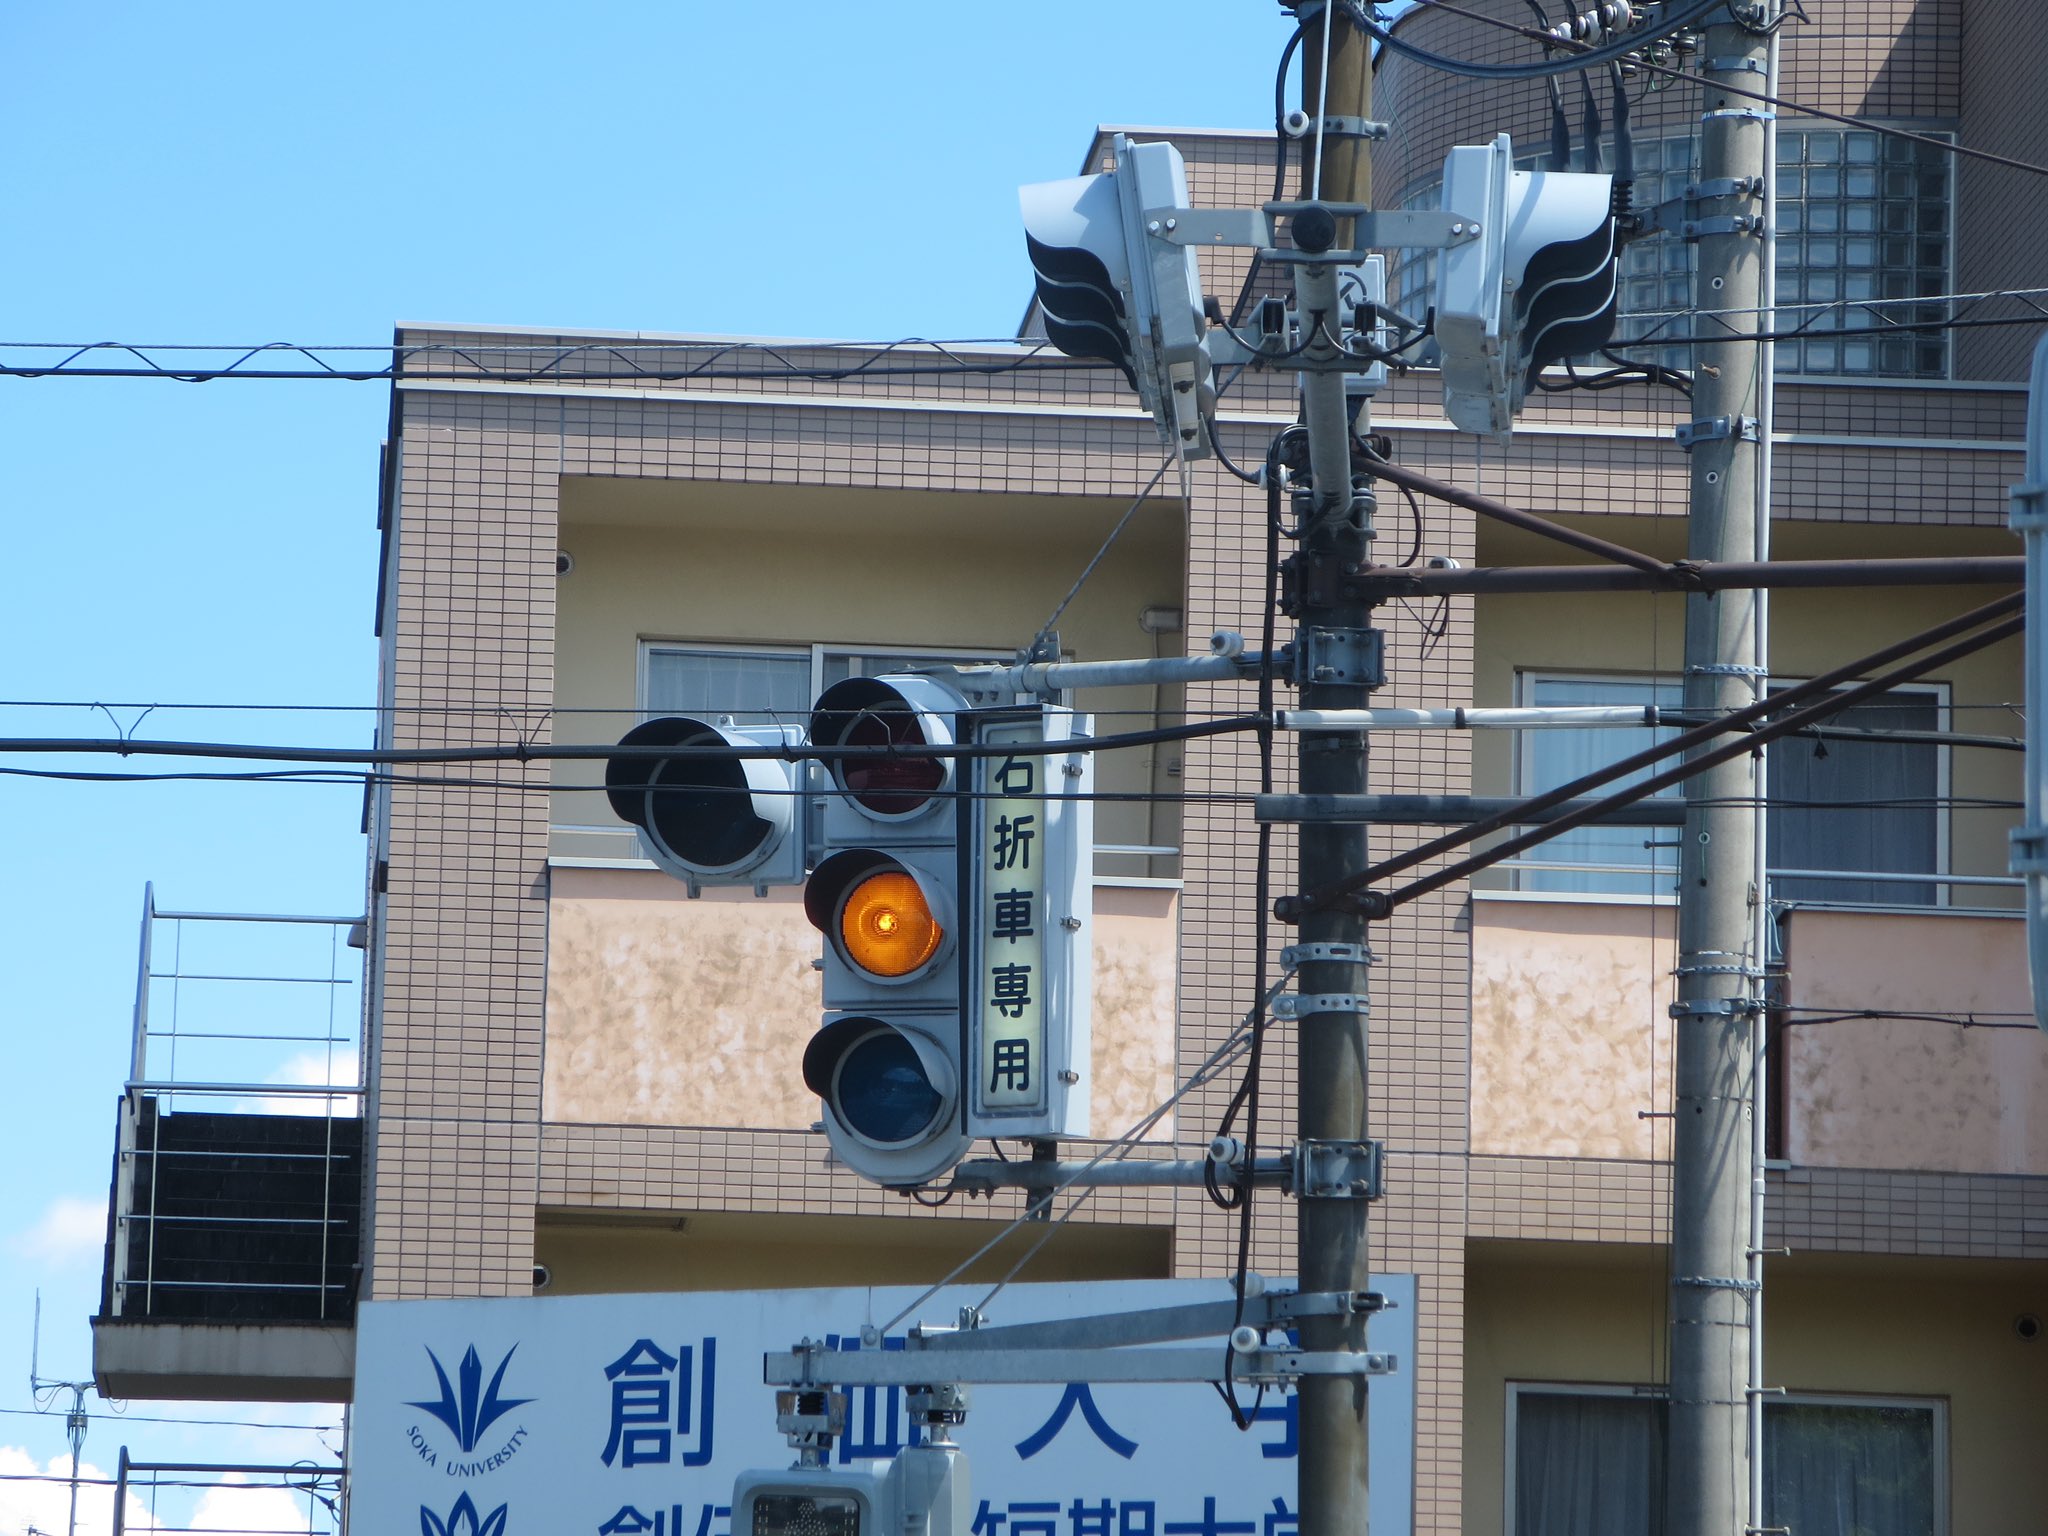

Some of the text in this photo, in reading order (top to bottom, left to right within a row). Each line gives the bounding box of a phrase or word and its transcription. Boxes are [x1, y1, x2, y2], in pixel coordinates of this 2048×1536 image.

[990, 740, 1035, 1093] 右折車専用
[406, 1424, 528, 1477] SOKA UNIVERSITY
